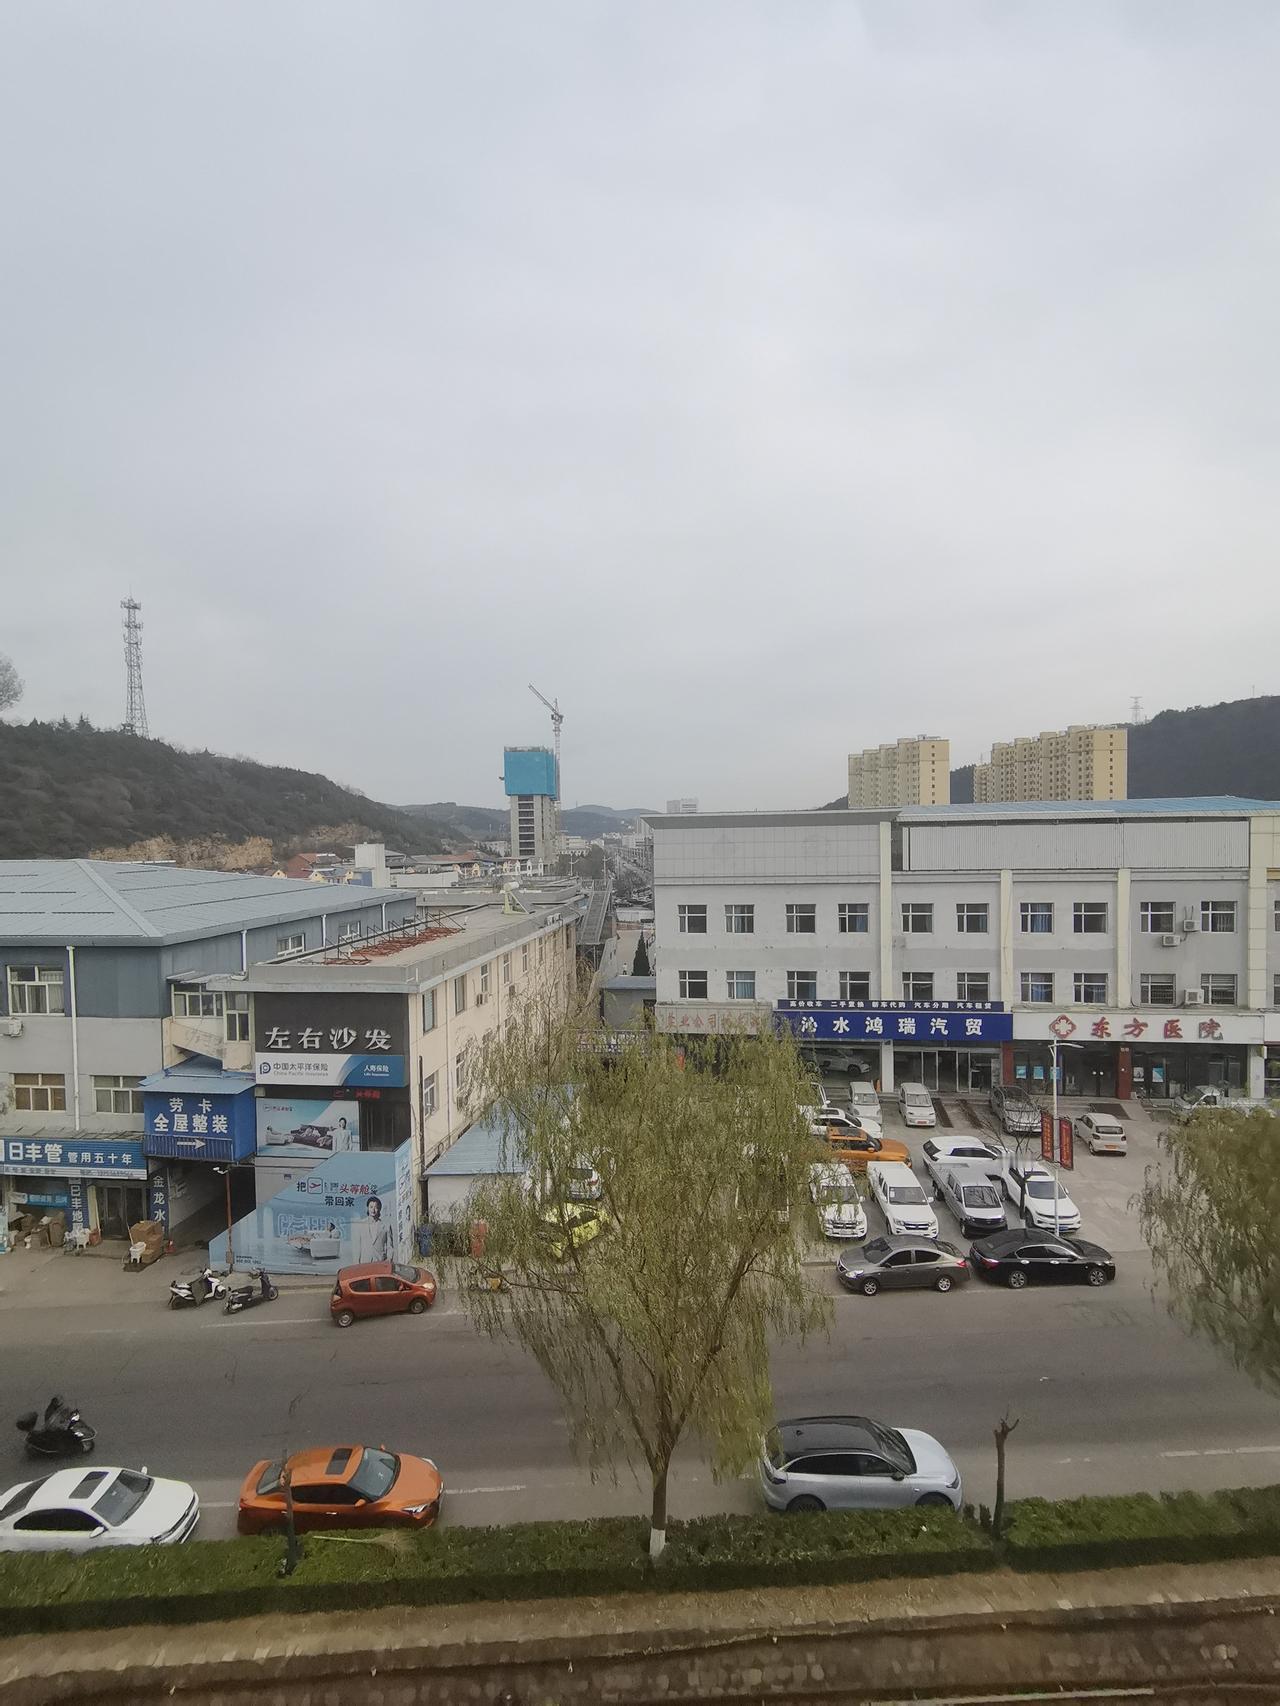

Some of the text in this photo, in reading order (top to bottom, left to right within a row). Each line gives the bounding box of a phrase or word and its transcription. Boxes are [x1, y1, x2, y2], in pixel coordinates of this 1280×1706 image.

[789, 1000, 823, 1008] 高价收车
[871, 1001, 906, 1009] 新车代购
[956, 1002, 992, 1010] 汽车租赁
[801, 1016, 983, 1036] 沁水鸿瑞汽贸
[1090, 1016, 1224, 1041] 东方医院
[264, 1026, 392, 1051] 左右沙发
[273, 1062, 390, 1073] 中国太平洋保险 人寿保险
[169, 1097, 213, 1114] 劳卡
[153, 1112, 229, 1134] 全屋整装
[8, 1141, 63, 1164] 日丰管
[67, 1151, 133, 1166] 管用五十年
[296, 1181, 307, 1193] 把
[153, 1175, 167, 1232] 金龙水
[324, 1195, 356, 1207] 带回家
